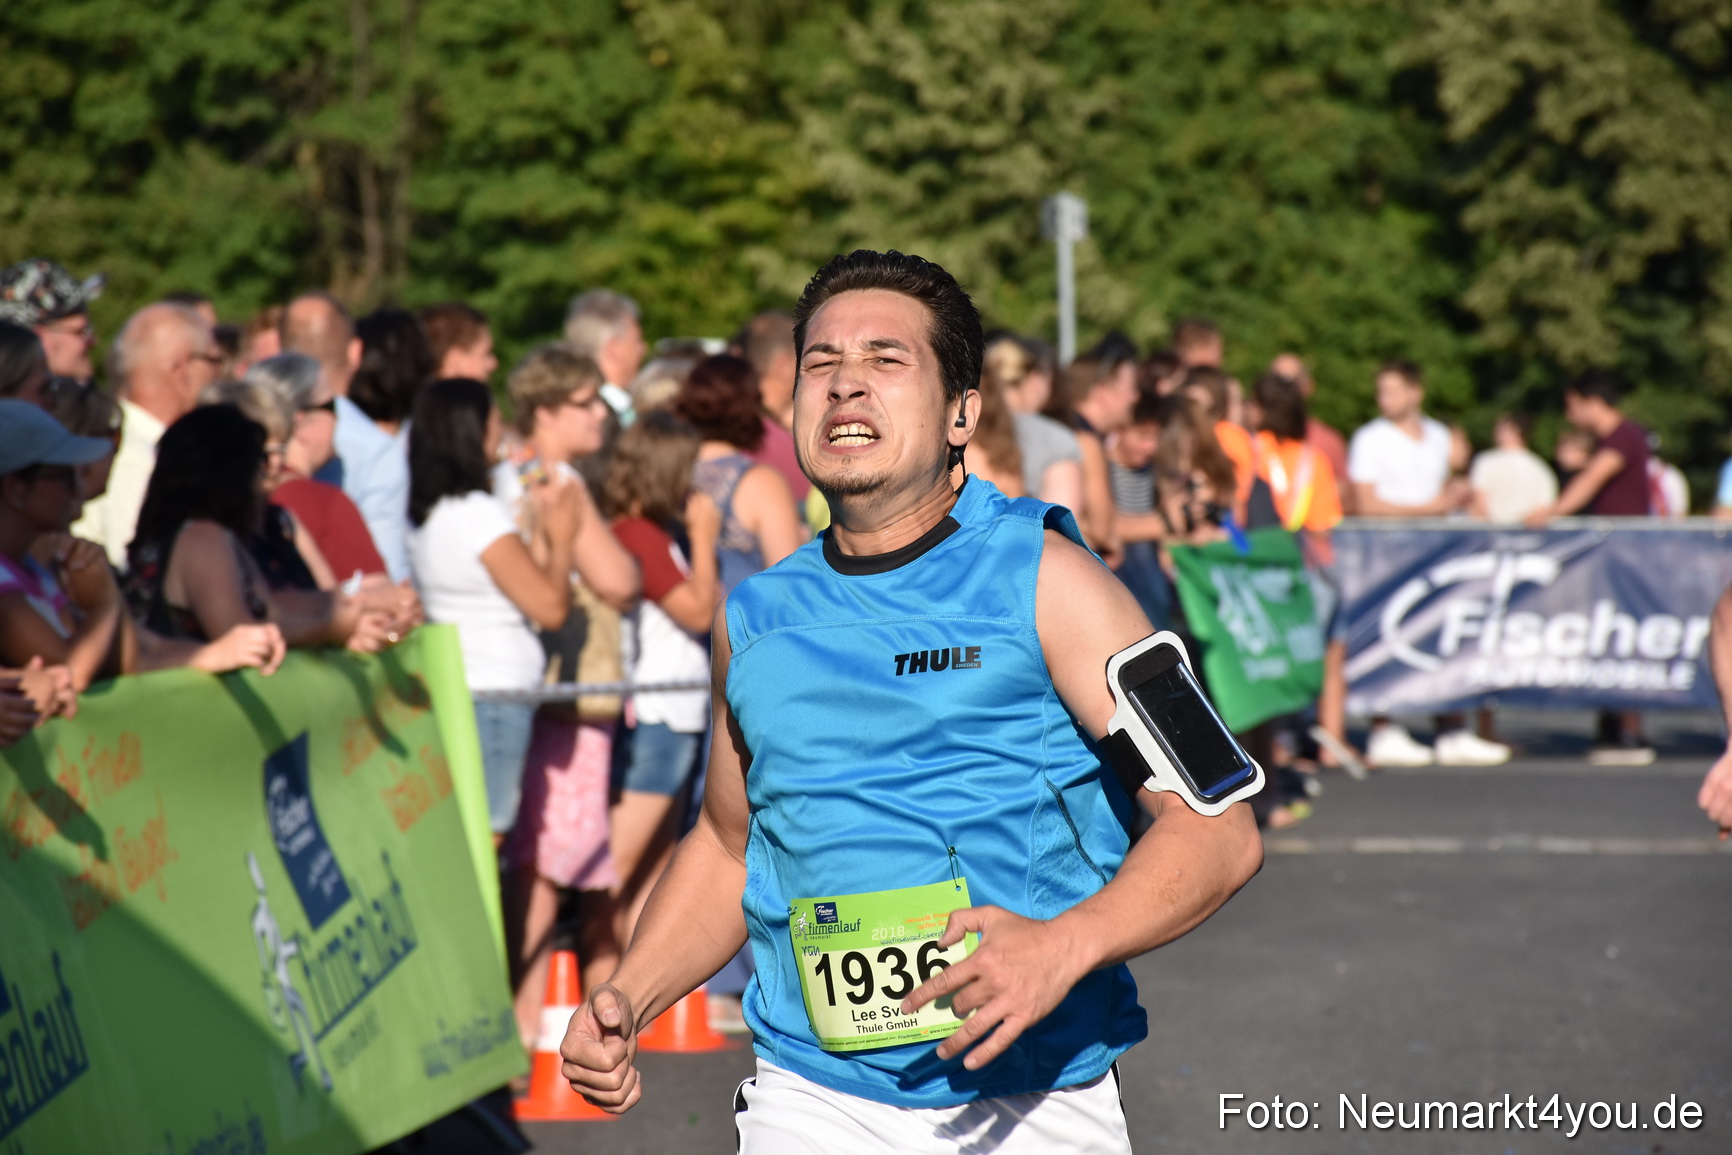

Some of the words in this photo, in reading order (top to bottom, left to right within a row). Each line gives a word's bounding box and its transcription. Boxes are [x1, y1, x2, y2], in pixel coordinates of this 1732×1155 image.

[1438, 599, 1711, 660] Fischer
[894, 645, 982, 676] THULE
[1466, 656, 1698, 691] AUTOMOBILE
[808, 918, 862, 935] firmenlauf
[871, 925, 906, 941] 2018
[814, 940, 952, 1007] 1936
[851, 1009, 878, 1022] Lee
[881, 1005, 919, 1018] Sv
[855, 1023, 883, 1034] Thule
[886, 1017, 918, 1030] GmbH
